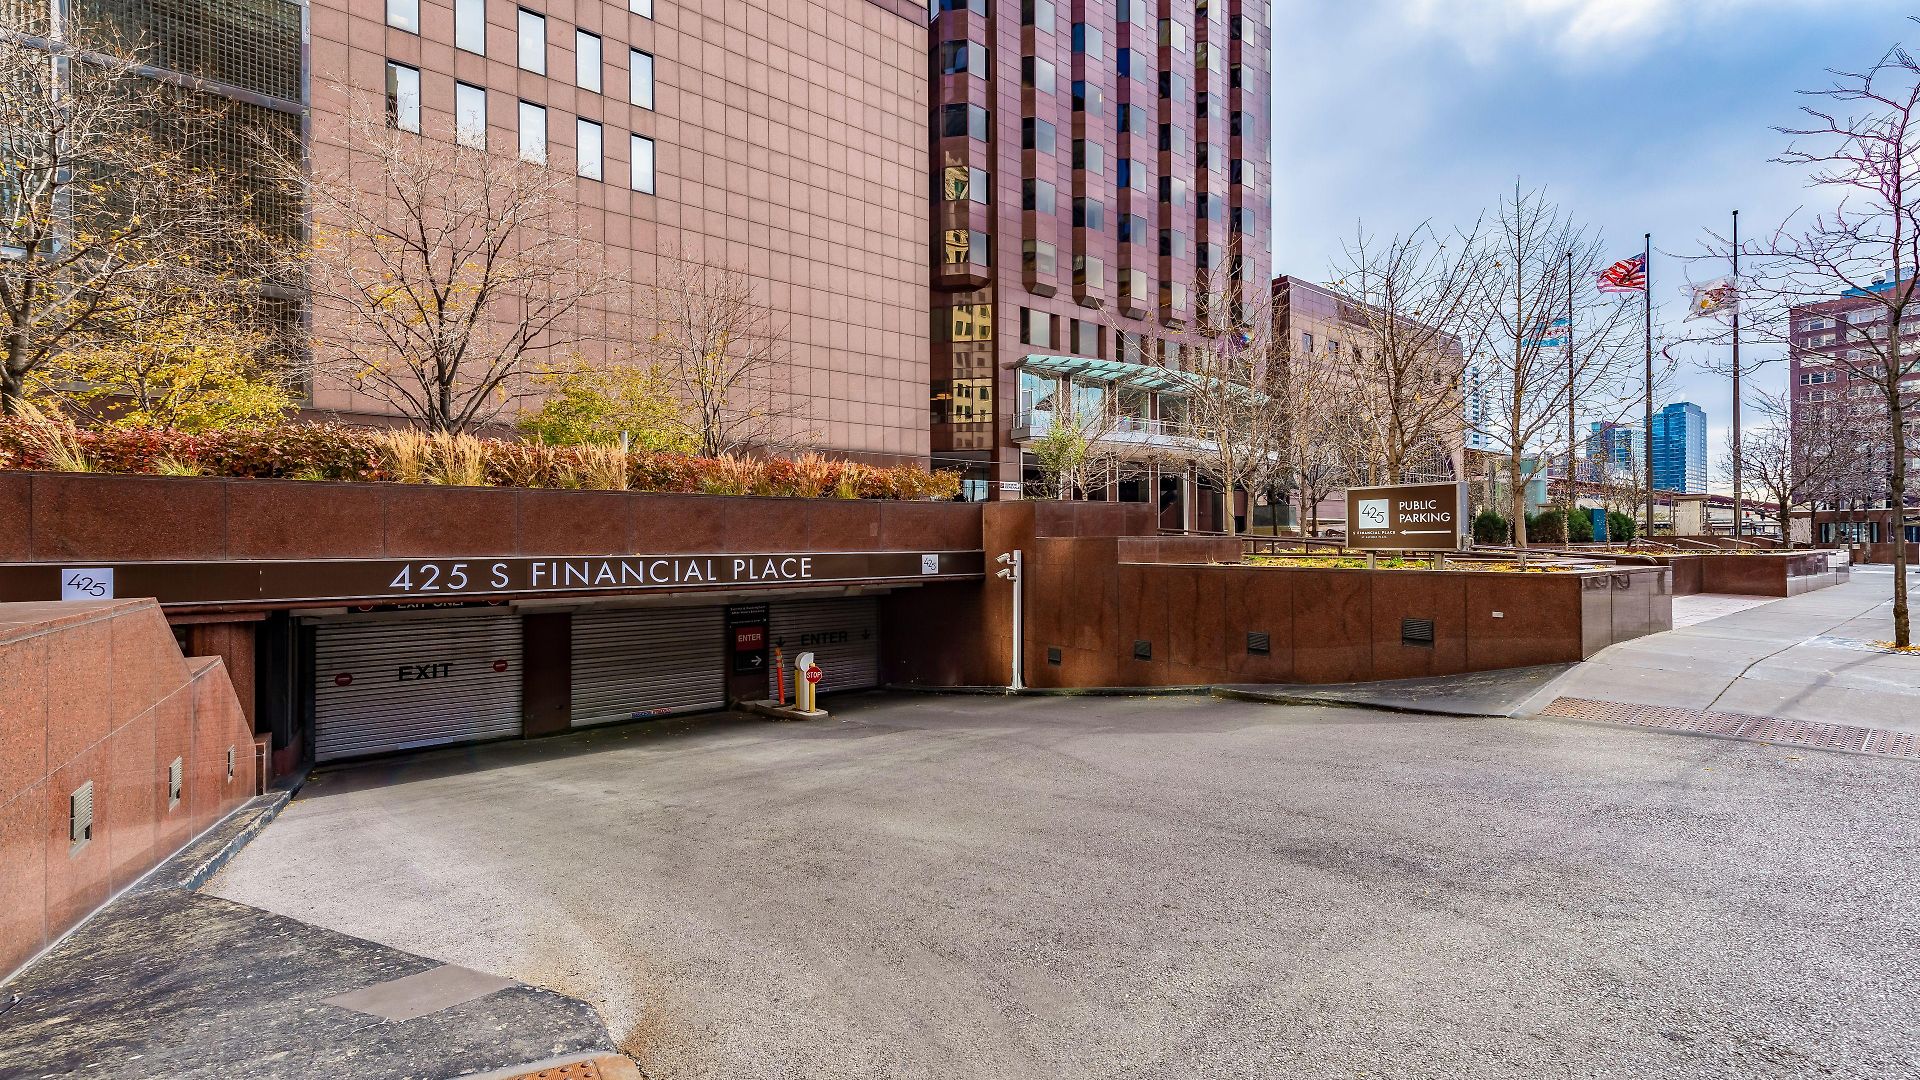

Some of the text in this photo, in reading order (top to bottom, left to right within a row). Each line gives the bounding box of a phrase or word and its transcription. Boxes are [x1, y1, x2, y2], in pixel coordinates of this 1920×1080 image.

[1399, 500, 1437, 511] PUBLIC
[1361, 503, 1385, 524] 425
[1399, 512, 1451, 524] PARKING
[923, 557, 937, 571] 425
[388, 557, 812, 591] 425 S FINANCIAL PLACE
[67, 573, 107, 597] 425
[738, 633, 761, 642] ENTER
[801, 630, 848, 646] ENTER
[398, 663, 453, 681] EXIT
[806, 671, 821, 679] STOP
